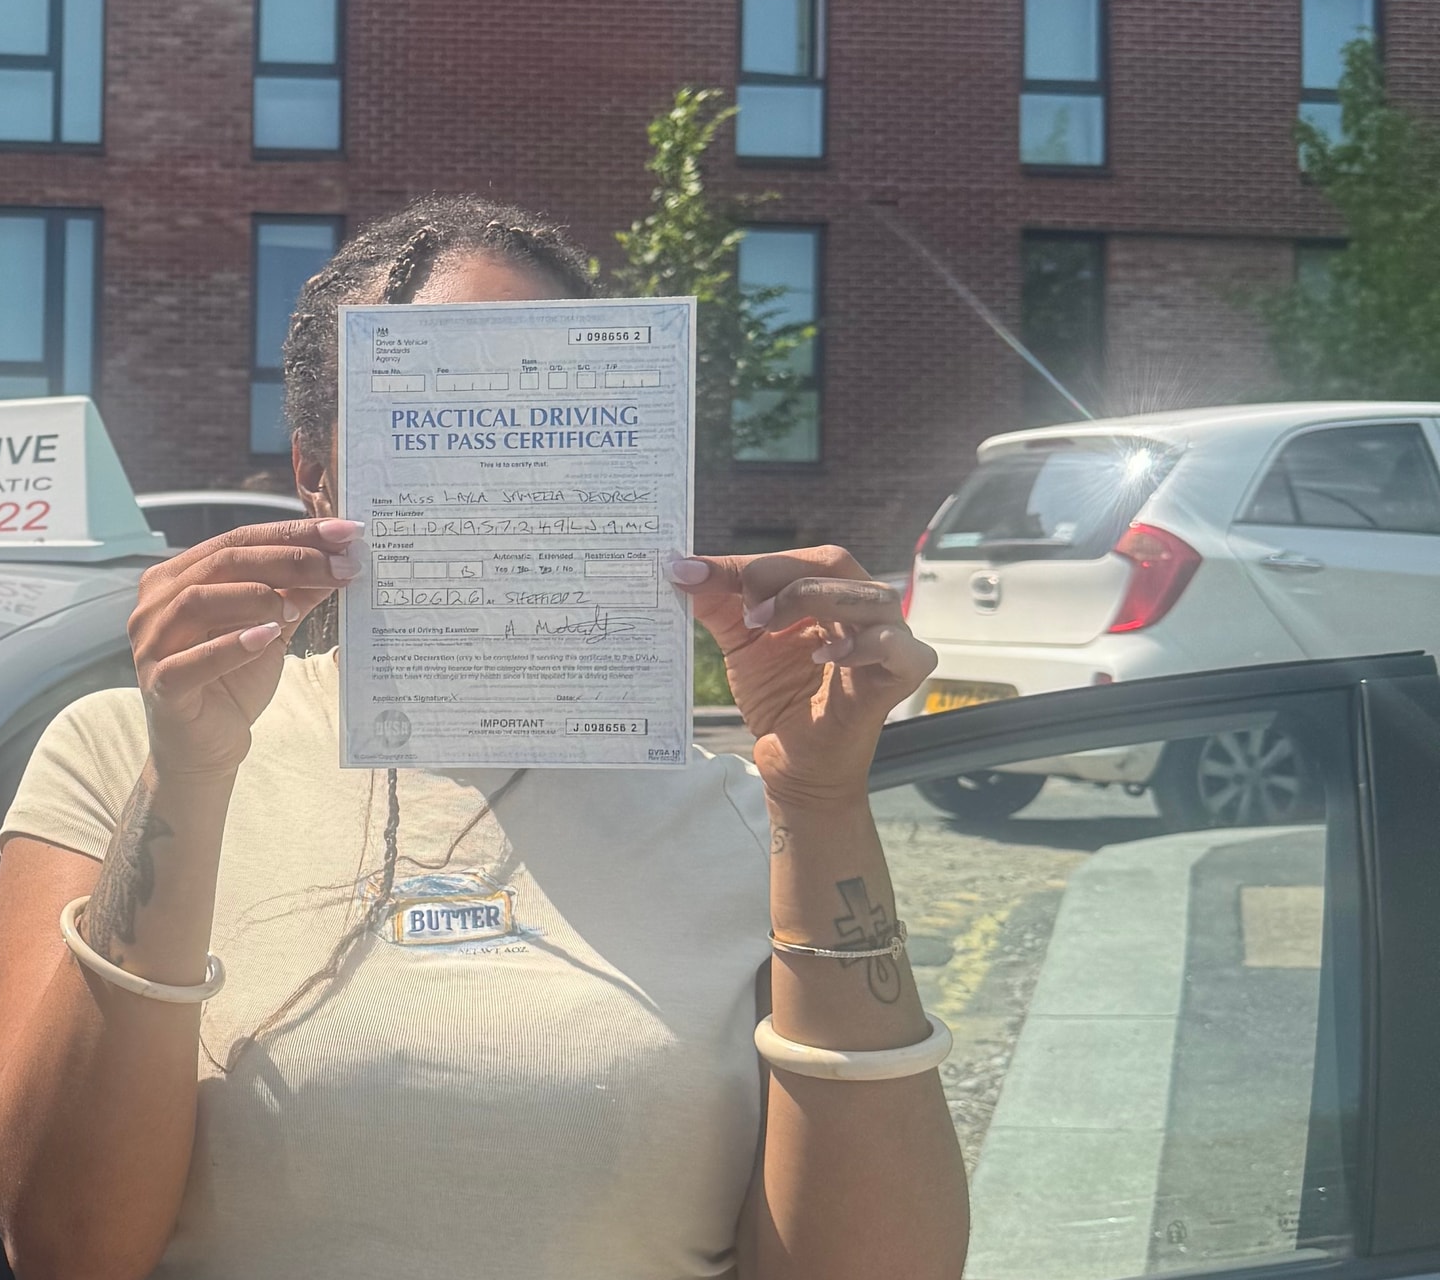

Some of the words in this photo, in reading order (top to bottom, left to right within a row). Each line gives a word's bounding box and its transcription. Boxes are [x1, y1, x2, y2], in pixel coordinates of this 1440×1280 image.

[575, 332, 582, 342] J
[586, 331, 630, 342] 098656
[633, 331, 641, 341] 2
[375, 355, 401, 364] Agency
[391, 408, 522, 429] PRACTICAL
[530, 405, 639, 427] DRIVING
[391, 433, 440, 451] TEST
[447, 432, 497, 451] PASS
[503, 430, 639, 449] CERTIFICATE
[493, 552, 532, 560] Automatic
[538, 552, 574, 560] Extended
[584, 552, 625, 560] Restriction
[417, 626, 444, 635] Driving
[480, 718, 545, 728] IMPORTANT
[572, 723, 580, 733] J
[584, 723, 627, 733] 098656
[631, 723, 639, 733] 2
[409, 905, 501, 933] BUTTER
